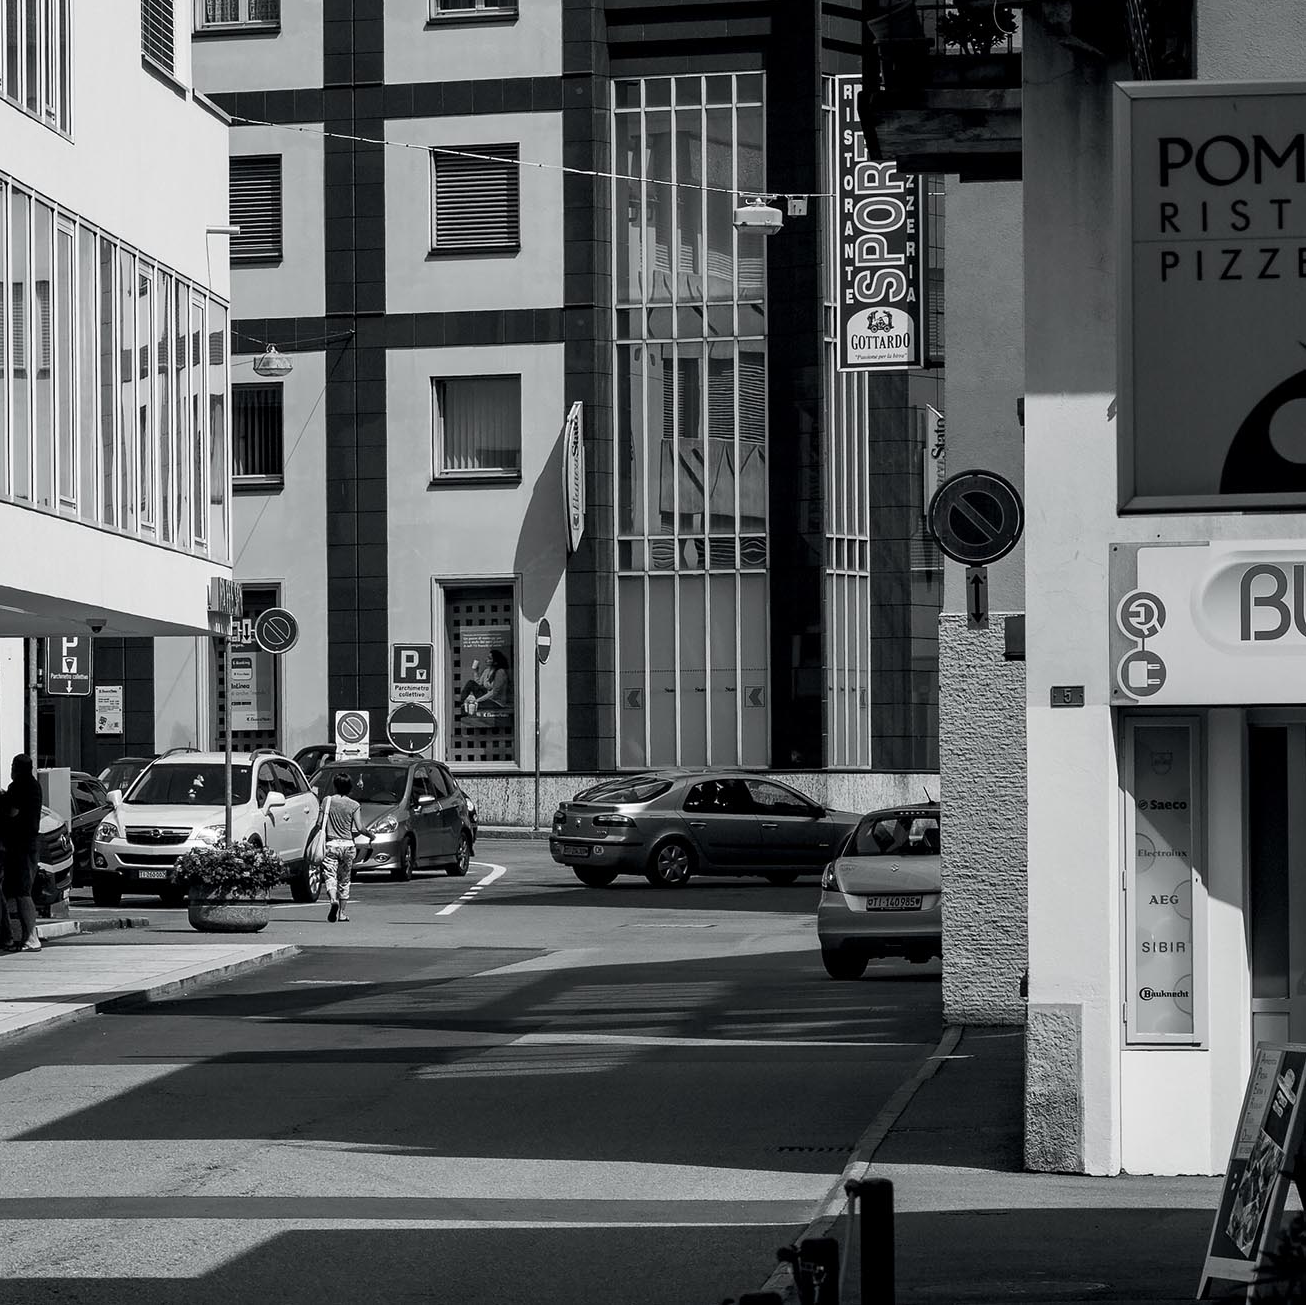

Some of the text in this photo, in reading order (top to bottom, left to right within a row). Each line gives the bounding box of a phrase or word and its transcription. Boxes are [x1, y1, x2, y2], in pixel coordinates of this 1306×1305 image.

[1158, 134, 1306, 187] POM
[843, 84, 854, 304] RISTORANTE
[1160, 199, 1292, 234] RIST
[851, 332, 910, 350] GOTTARDO
[401, 650, 419, 678] P
[1149, 799, 1187, 810] Saeco
[1138, 848, 1188, 857] Electrolux
[1149, 895, 1179, 905] AEG
[1141, 941, 1186, 953] SIBIR
[1140, 987, 1189, 1000] Bauknecht
